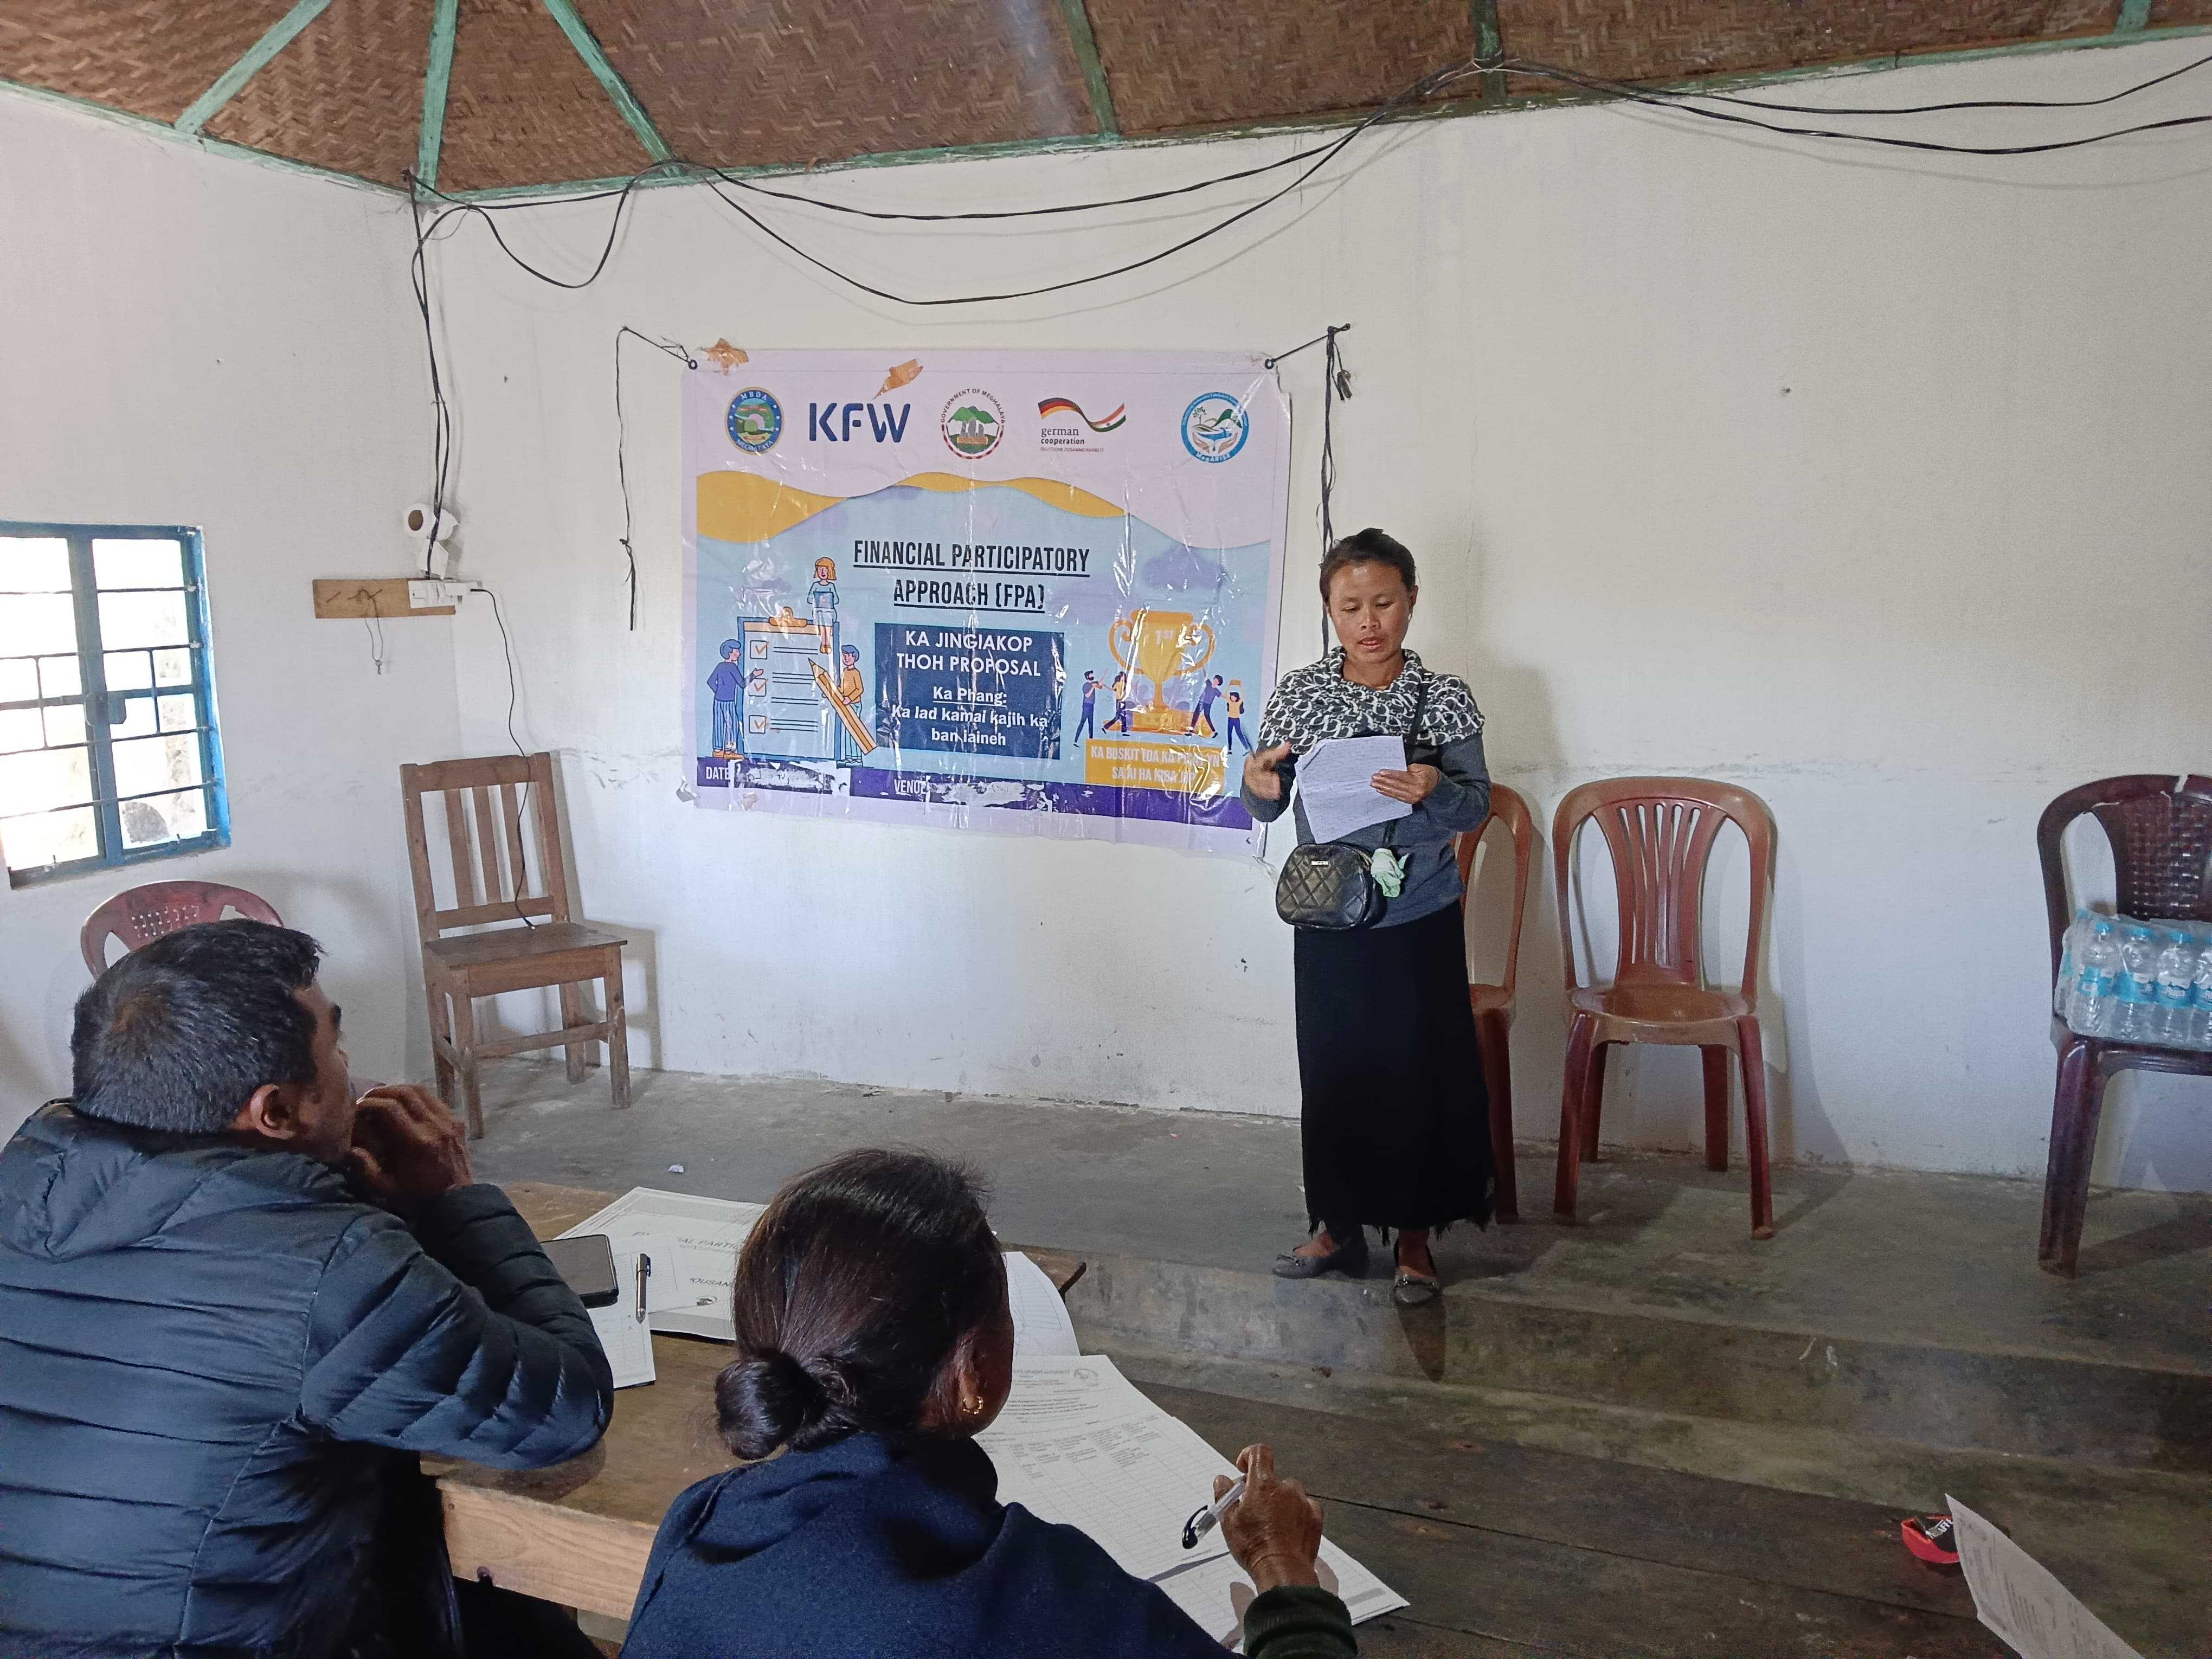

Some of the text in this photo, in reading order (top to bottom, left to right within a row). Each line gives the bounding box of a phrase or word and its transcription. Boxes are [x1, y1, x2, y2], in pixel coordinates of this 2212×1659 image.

[740, 391, 767, 401] MBDA
[941, 389, 970, 423] GOVERNMENT
[982, 390, 1005, 423] MEGHALAYA
[809, 402, 911, 443] KFW
[1041, 428, 1079, 438] german
[854, 540, 1090, 572] FINANCIAL PARTICIPATORY
[894, 579, 988, 606] APPROACH
[906, 631, 1033, 652] KA JINGIAKOP
[897, 653, 1041, 677] THOH PROPOSAL
[933, 686, 1007, 706] Ka Phang:
[892, 705, 910, 718] Ka
[942, 708, 986, 723] kamai
[991, 711, 1025, 728] kajih
[1030, 713, 1047, 728] ka
[931, 728, 1006, 745] ban iaineh
[1091, 746, 1104, 758] KA
[1107, 747, 1140, 761] BUSKIT
[1139, 768, 1152, 781] HA
